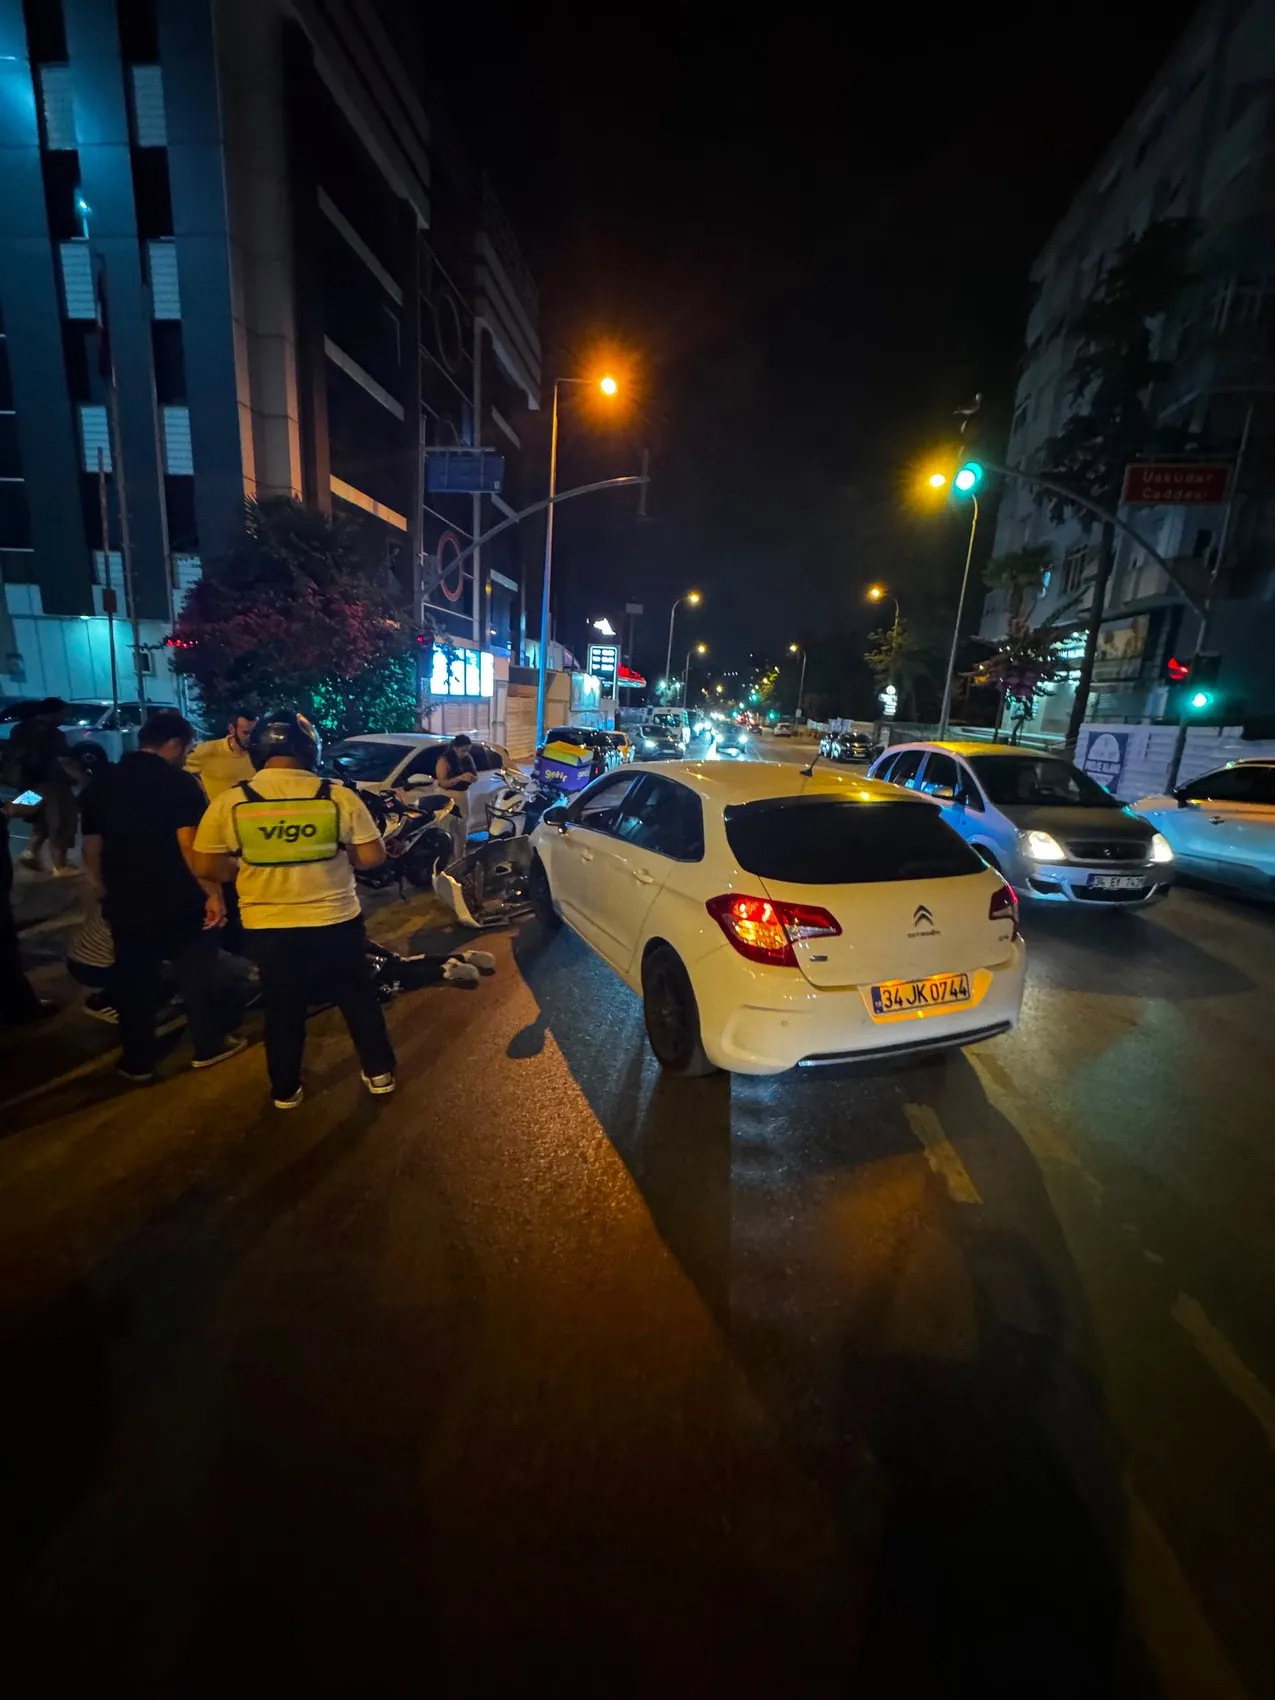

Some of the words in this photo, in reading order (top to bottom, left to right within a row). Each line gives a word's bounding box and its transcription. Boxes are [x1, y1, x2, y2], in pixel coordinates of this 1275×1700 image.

[258, 819, 317, 843] vigo
[882, 988, 903, 1009] 34
[906, 984, 928, 1005] JK
[930, 978, 967, 1001] 0744
